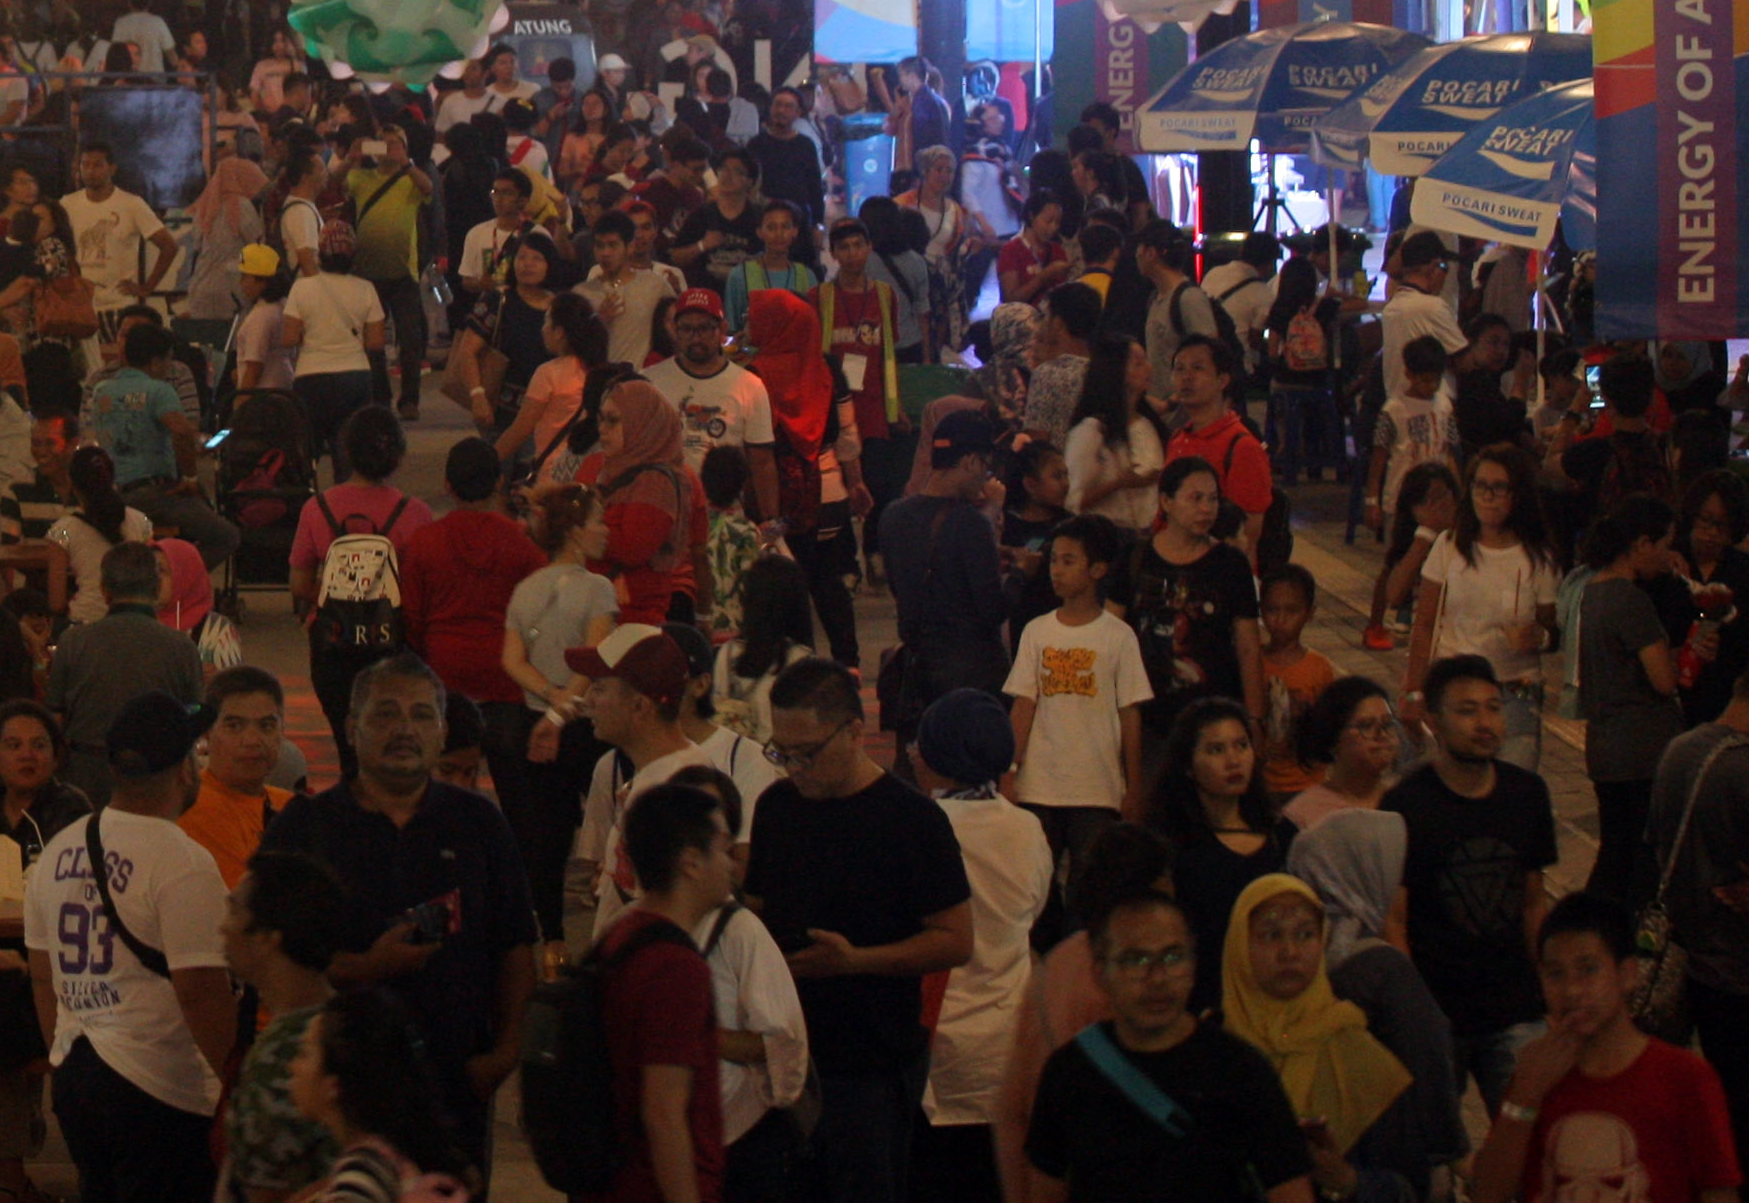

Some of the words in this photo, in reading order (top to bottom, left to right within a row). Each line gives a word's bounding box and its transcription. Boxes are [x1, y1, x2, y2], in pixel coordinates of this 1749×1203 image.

[514, 18, 573, 35] ATUNG
[1288, 62, 1378, 77] POCARI
[1676, 36, 1711, 103] OF
[1289, 74, 1371, 87] SWEAT
[1425, 79, 1521, 94] POCARI
[1421, 90, 1503, 105] SWEAT
[1490, 126, 1575, 144] POCARI
[1397, 140, 1451, 152] POCARI
[1481, 138, 1557, 156] SWEAT
[1442, 191, 1497, 214] POCARI
[1499, 205, 1543, 223] SWEAT
[1678, 109, 1714, 304] ENERGY
[54, 846, 134, 894] CLSS
[57, 901, 116, 975] 93
